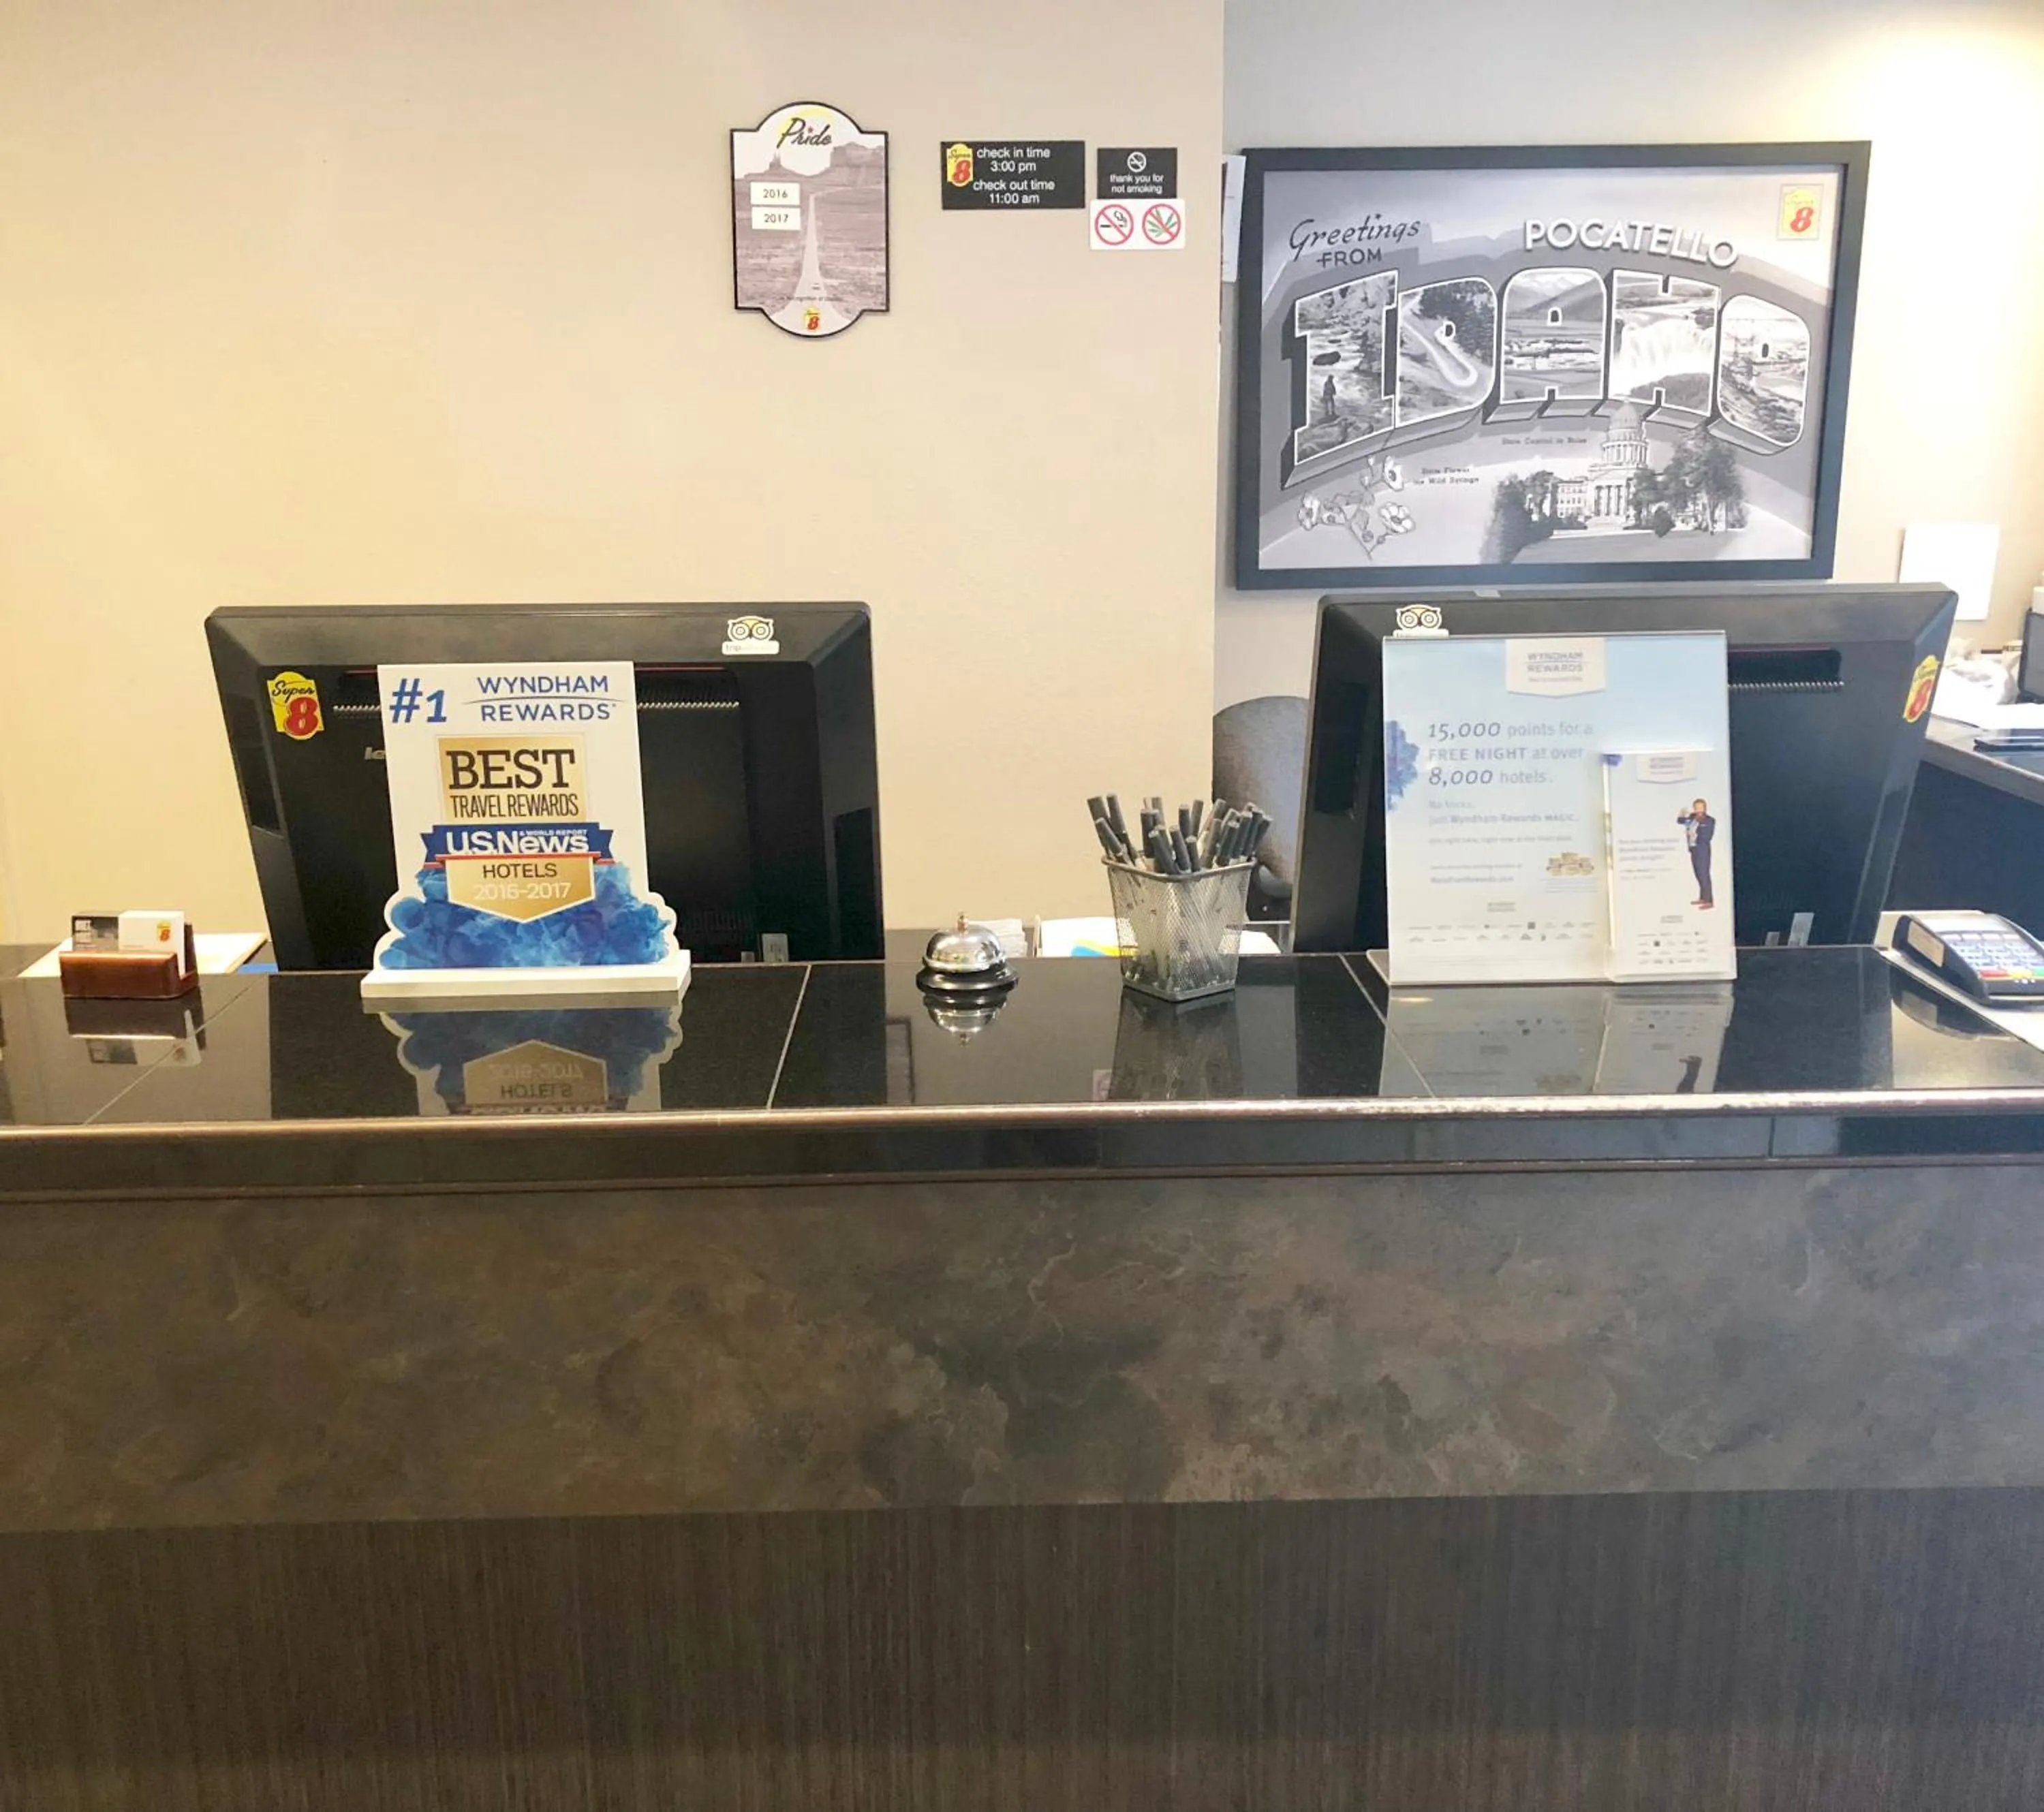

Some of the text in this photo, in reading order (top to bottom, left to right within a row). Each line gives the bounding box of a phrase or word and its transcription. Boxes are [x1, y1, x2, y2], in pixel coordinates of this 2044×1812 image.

[776, 117, 833, 149] Pride
[976, 147, 1051, 158] check in time
[953, 159, 971, 183] 8
[990, 161, 1037, 174] 3:00 pm
[973, 180, 1055, 191] check out time
[1110, 173, 1164, 186] thank you for
[1111, 184, 1163, 195] not smoking
[762, 189, 789, 200] 2016
[989, 193, 1040, 204] 11:00 am
[764, 213, 790, 223] 2017
[1789, 206, 1815, 233] 8
[1289, 213, 1421, 262] Greetings
[1524, 218, 1739, 268] POCATELLO
[1316, 248, 1382, 268] FROM
[1281, 266, 1812, 490] IDAHO
[1527, 664, 1583, 673] REWARDS
[272, 680, 315, 704] Super
[476, 675, 608, 695] WYNDHAM
[389, 678, 448, 723] #1
[284, 696, 318, 736] 8
[481, 703, 611, 722] REWARDS
[1428, 721, 1594, 743] 15,000 points for a
[1428, 747, 1583, 761] FREE NIGHT at over
[446, 749, 575, 790] BEST
[1428, 766, 1554, 788] 8,000 hotels.
[450, 794, 578, 818] TRAVEL REWARDS
[483, 862, 557, 879] HOTELS
[474, 883, 571, 899] 2016-2017
